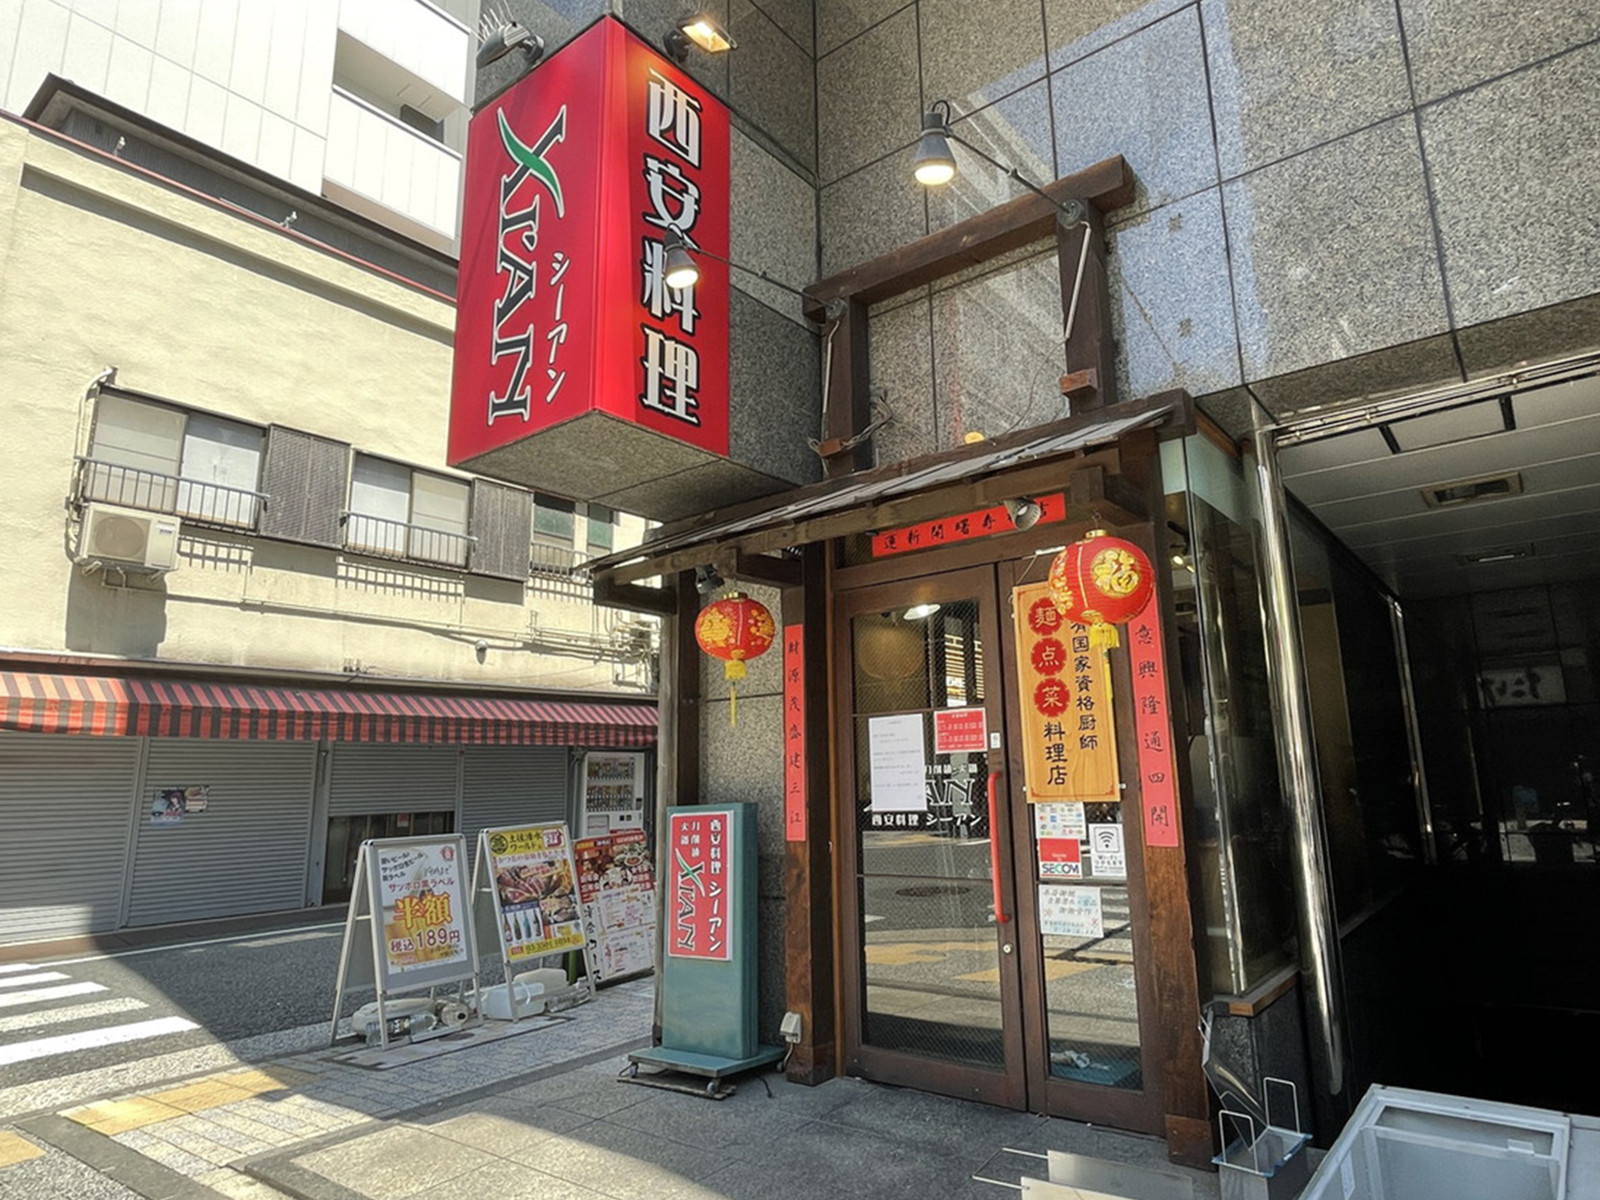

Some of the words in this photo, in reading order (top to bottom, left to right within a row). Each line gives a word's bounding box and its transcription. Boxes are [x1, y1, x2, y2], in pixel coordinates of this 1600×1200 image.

[488, 104, 567, 427] XIAN
[641, 67, 703, 426] 西安料理
[547, 251, 570, 403] シーアン
[710, 820, 721, 874] 西安料理
[871, 814, 919, 826] 西安料理
[926, 813, 981, 826] シーアン
[675, 847, 706, 951] XIAN
[1042, 862, 1080, 874] SECOM
[391, 939, 414, 953] 税込
[416, 928, 461, 949] 189円
[393, 891, 453, 930] 半額
[709, 881, 722, 952] シーアン
